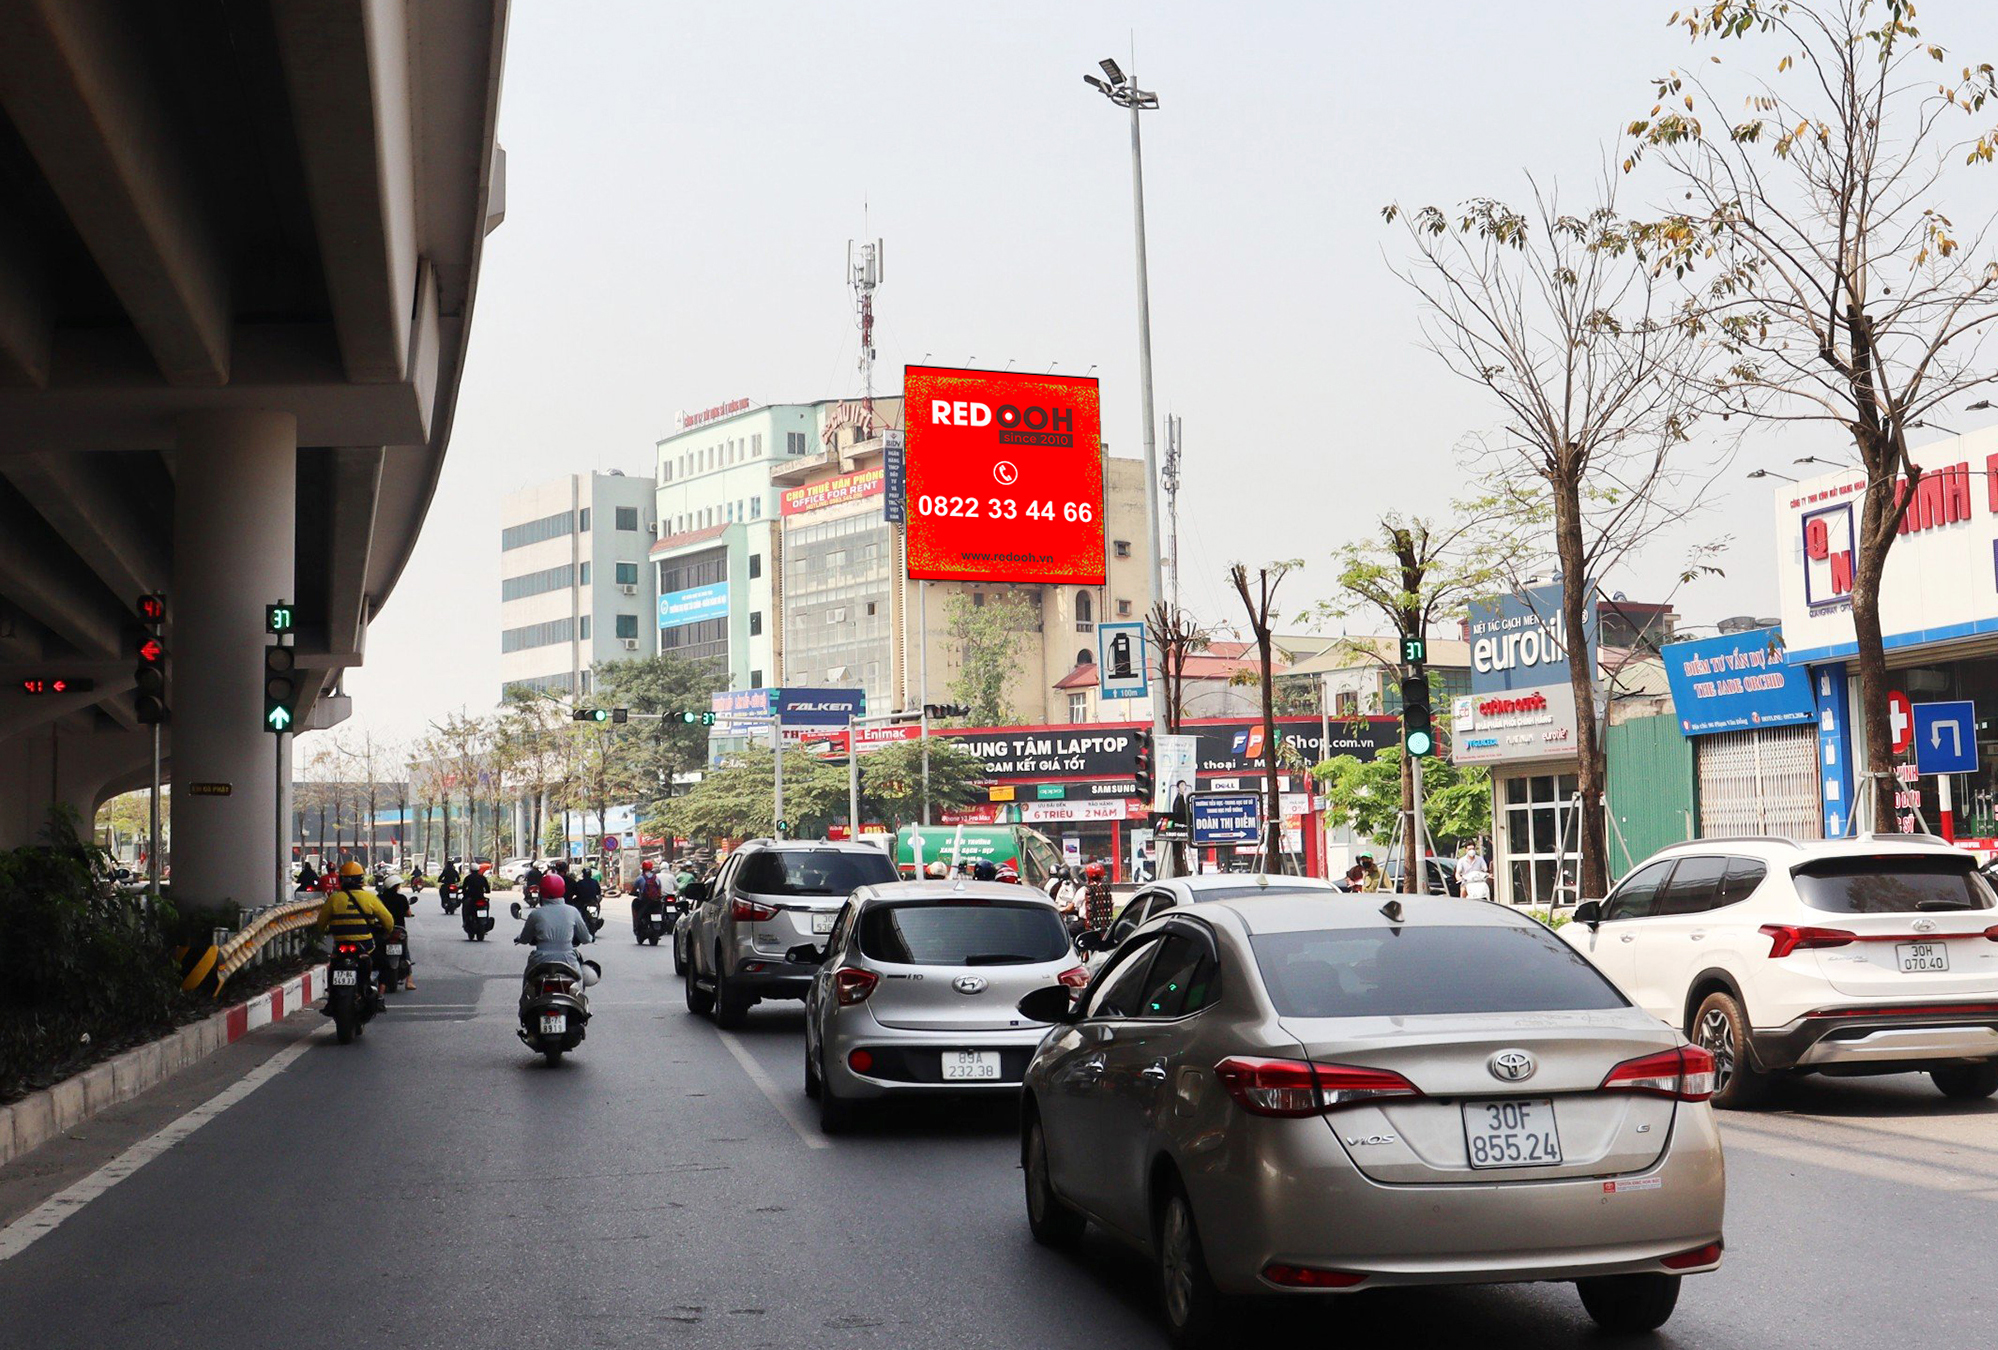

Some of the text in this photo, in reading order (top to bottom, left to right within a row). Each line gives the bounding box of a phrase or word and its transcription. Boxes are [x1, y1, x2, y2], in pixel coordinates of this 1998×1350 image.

[932, 400, 1072, 432] RED OOH
[1004, 432, 1068, 446] since 2010
[786, 489, 804, 502] CHO
[807, 482, 830, 496] THUÊ
[792, 480, 878, 508] OFFICE FOR RENT
[918, 495, 1092, 522] 0822 33 44 66
[1806, 518, 1828, 561] Q
[961, 551, 1054, 564] www.redooh.vn
[1830, 550, 1852, 594] N
[274, 610, 290, 628] 37
[1473, 620, 1486, 636] KIỆT
[1488, 619, 1500, 632] TÁC
[1502, 616, 1522, 631] GẠCH
[1406, 642, 1422, 660] 37
[24, 681, 42, 692] 41
[1694, 672, 1784, 698] THE JADE ORCHID
[787, 702, 852, 712] FALKEN
[702, 713, 715, 724] 37
[864, 728, 906, 740] Enimac
[1012, 736, 1051, 756] TÂM
[1057, 736, 1128, 754] LAPTOP
[1016, 757, 1036, 772] KẾT
[1039, 756, 1061, 771] GIÁ
[1064, 754, 1086, 770] TỐT
[1204, 759, 1236, 770] thoại
[1092, 784, 1136, 794] SAMSUNG
[1034, 811, 1040, 819] 6
[1085, 810, 1091, 818] 2
[1196, 812, 1256, 831] ĐOÀN THỊ ĐIỂM
[1912, 946, 1933, 957] 30H
[1905, 957, 1943, 970] 070.40
[959, 1052, 982, 1064] 89A
[950, 1066, 994, 1078] 232.38
[1486, 1102, 1532, 1131] 30F
[1346, 1124, 1652, 1146] VIOS G
[1473, 1132, 1558, 1162] 855.24
